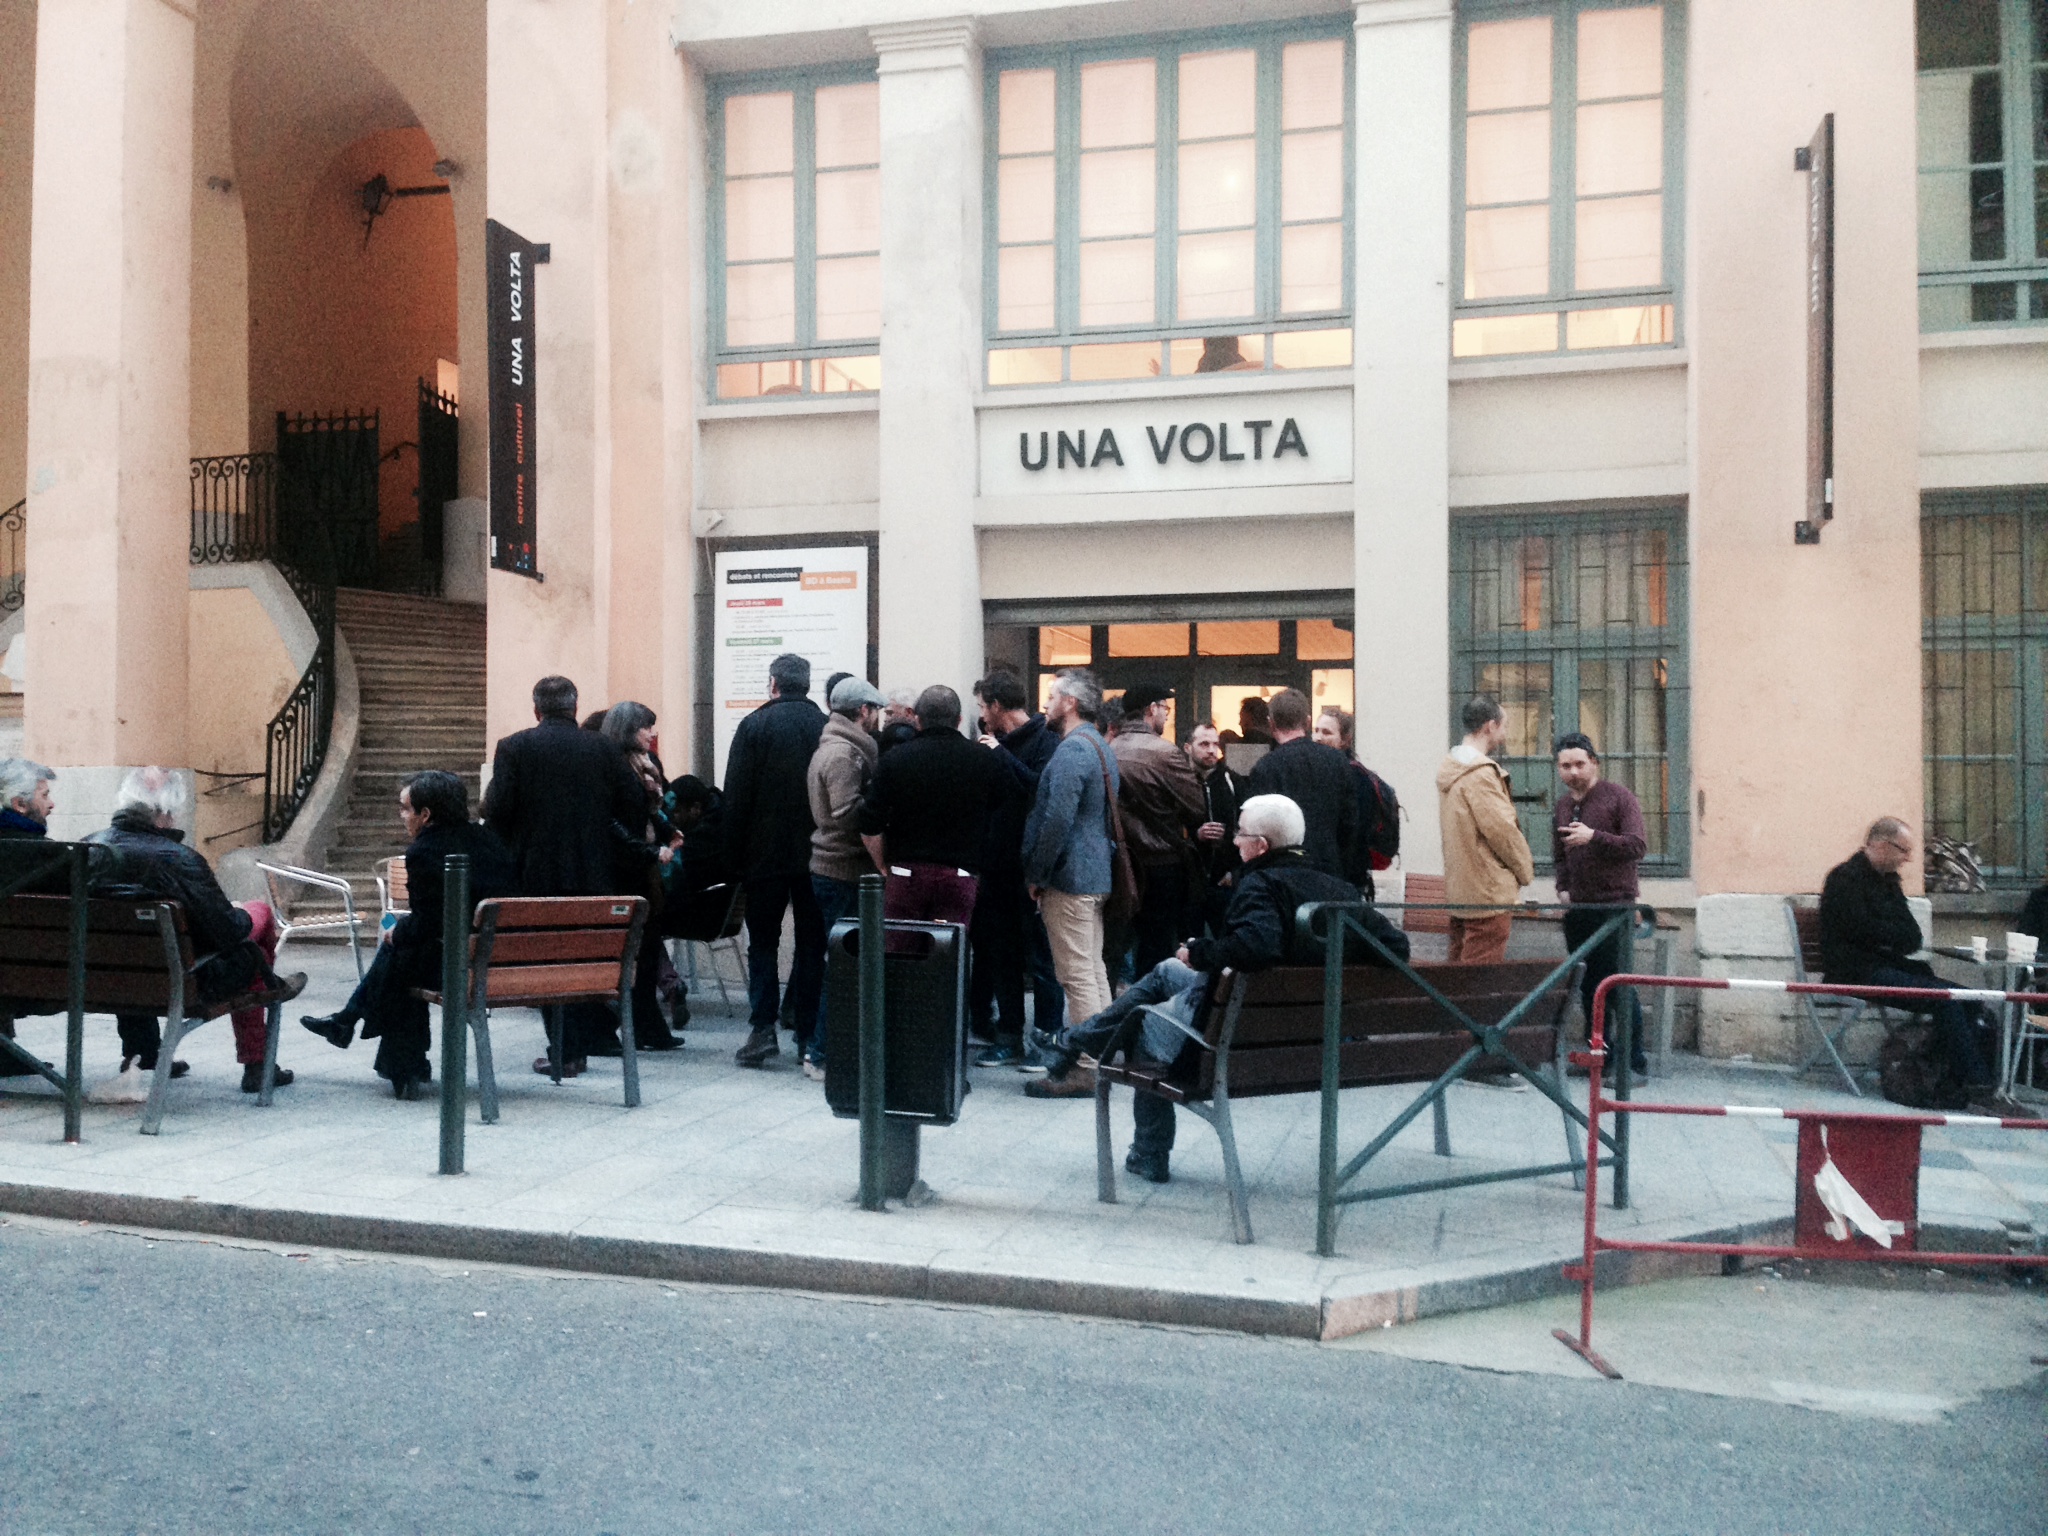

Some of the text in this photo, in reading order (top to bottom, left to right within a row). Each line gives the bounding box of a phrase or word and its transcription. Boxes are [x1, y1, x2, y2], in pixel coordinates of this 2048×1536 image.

[509, 251, 524, 525] centre culturel UNA VOLTA
[1019, 418, 1309, 472] UNA VOLTA
